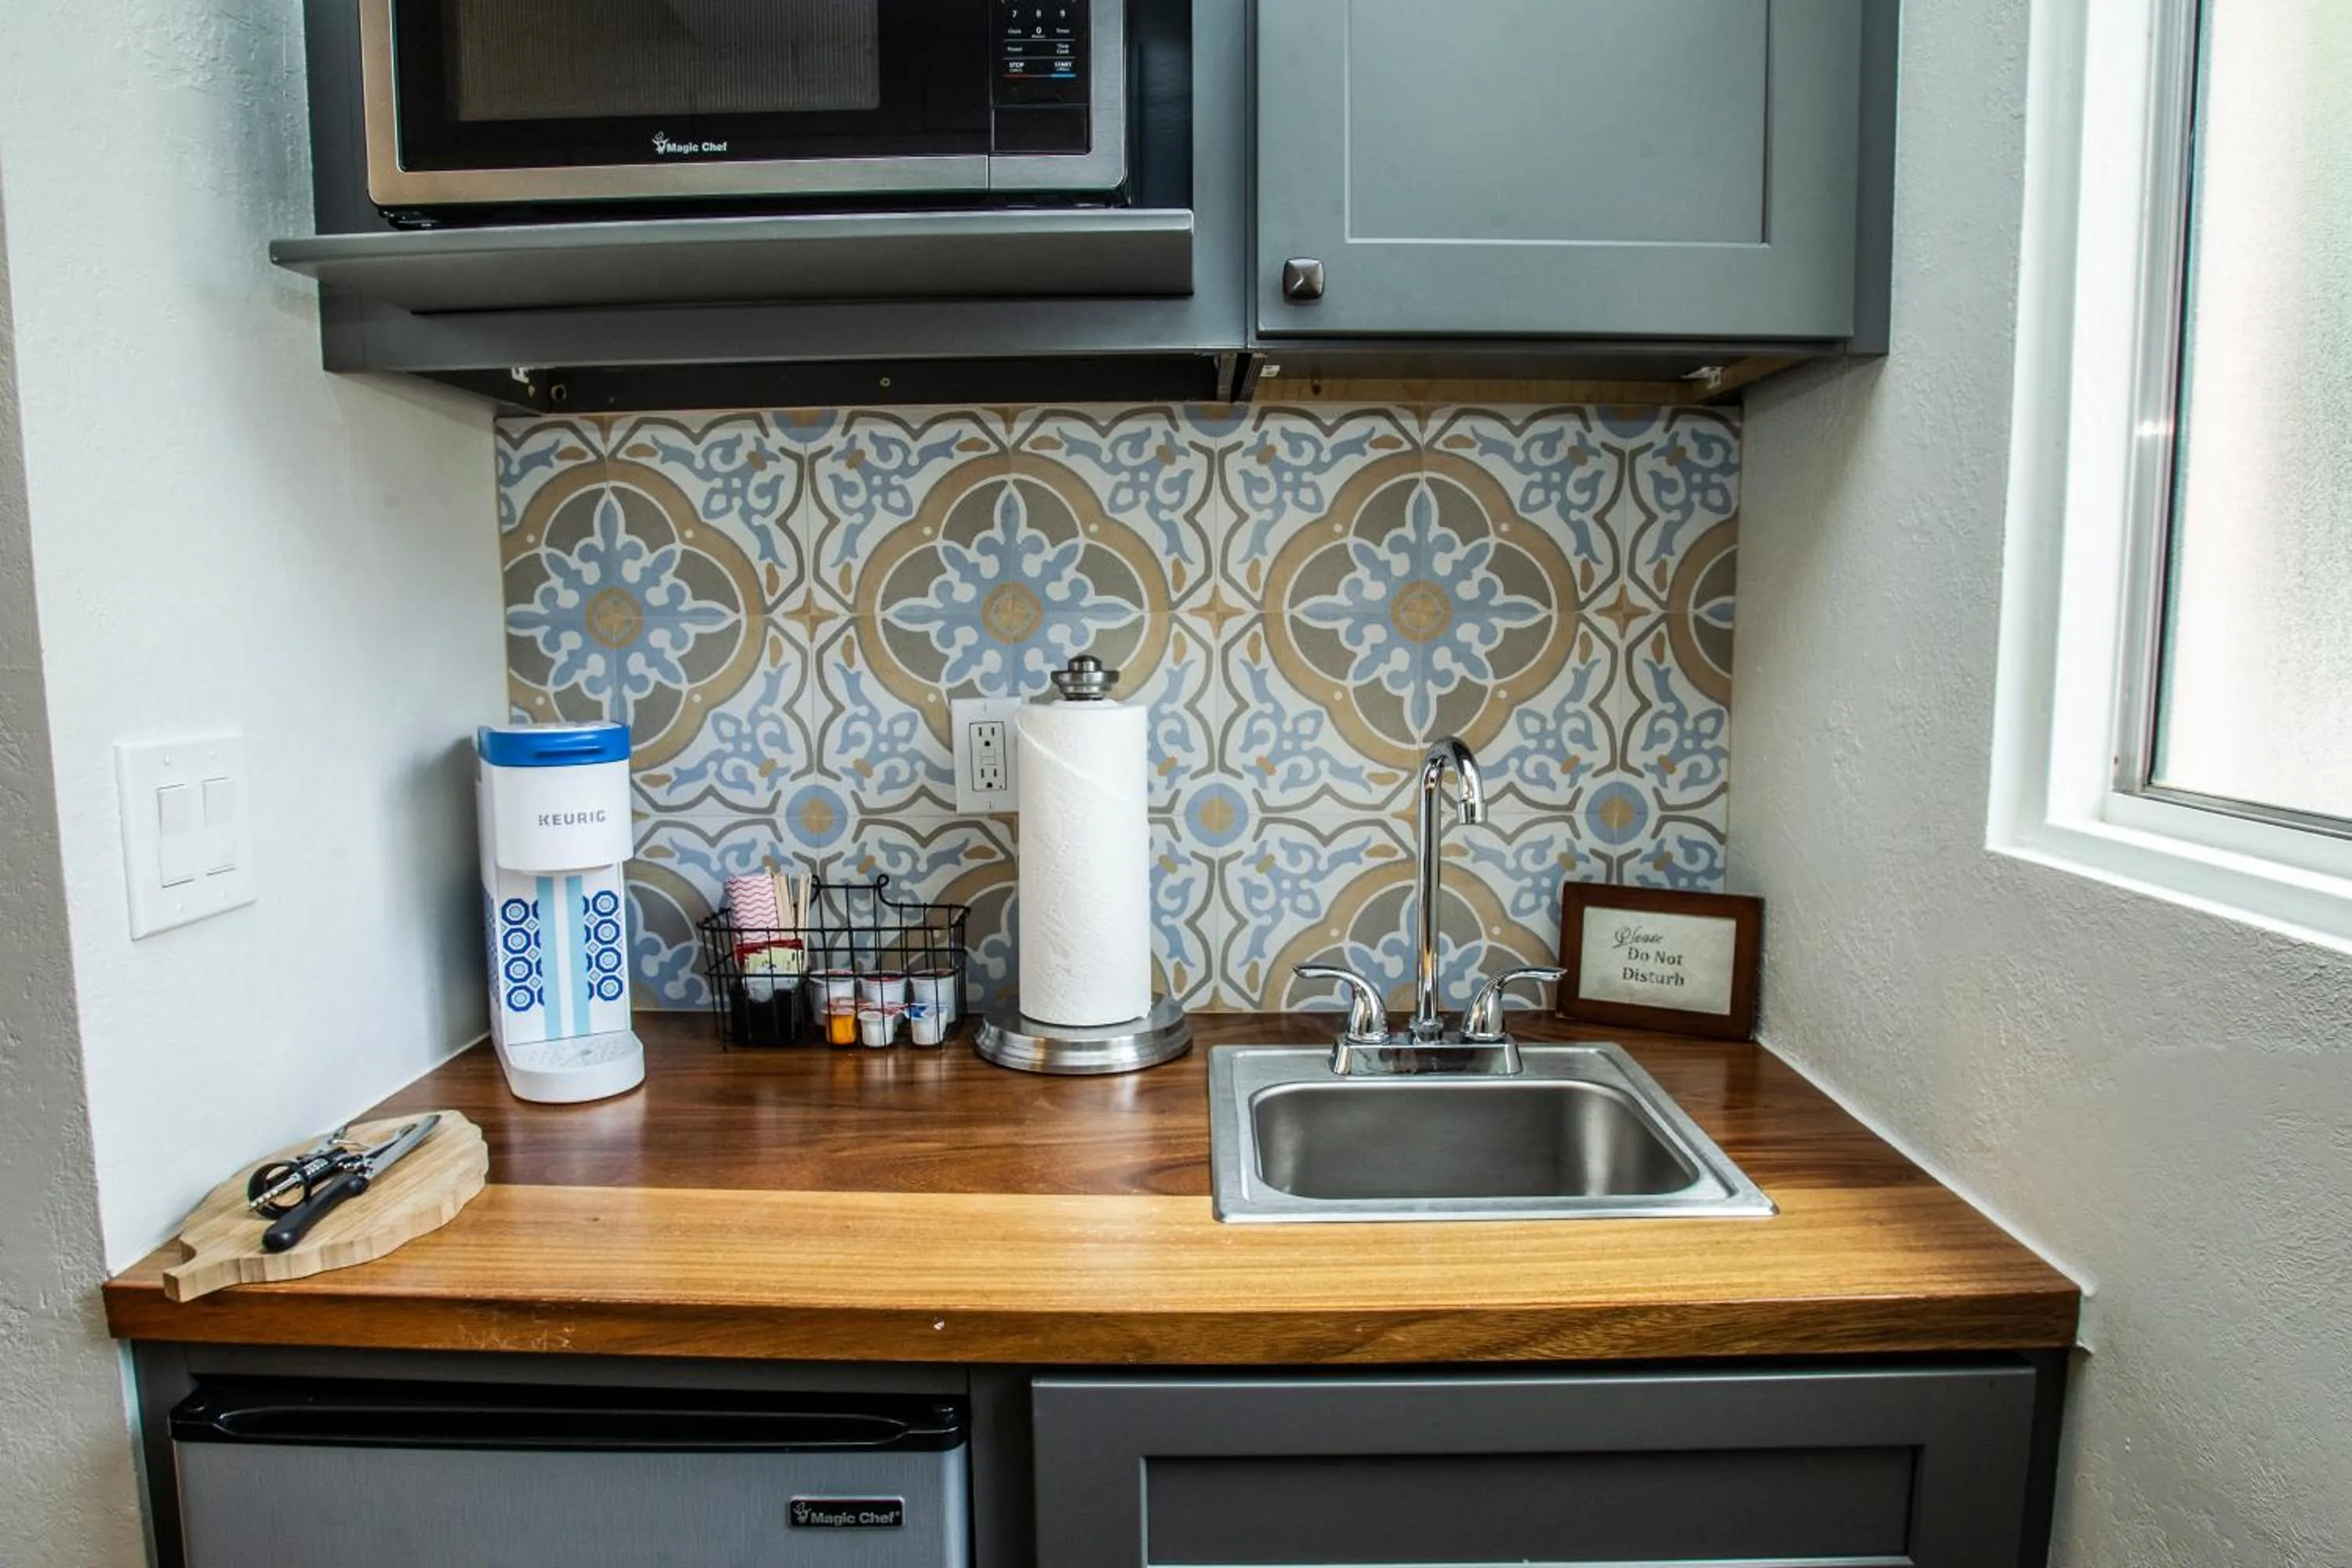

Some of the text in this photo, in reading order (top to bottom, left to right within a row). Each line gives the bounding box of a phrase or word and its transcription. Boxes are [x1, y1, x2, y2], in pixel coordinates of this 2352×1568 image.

[666, 142, 728, 154] Magic Chef
[539, 809, 606, 826] KEURIG
[1612, 926, 1664, 949] Please
[1628, 947, 1682, 966] Do Not
[1622, 967, 1685, 987] Disturb
[811, 1511, 895, 1526] Magic Chef
